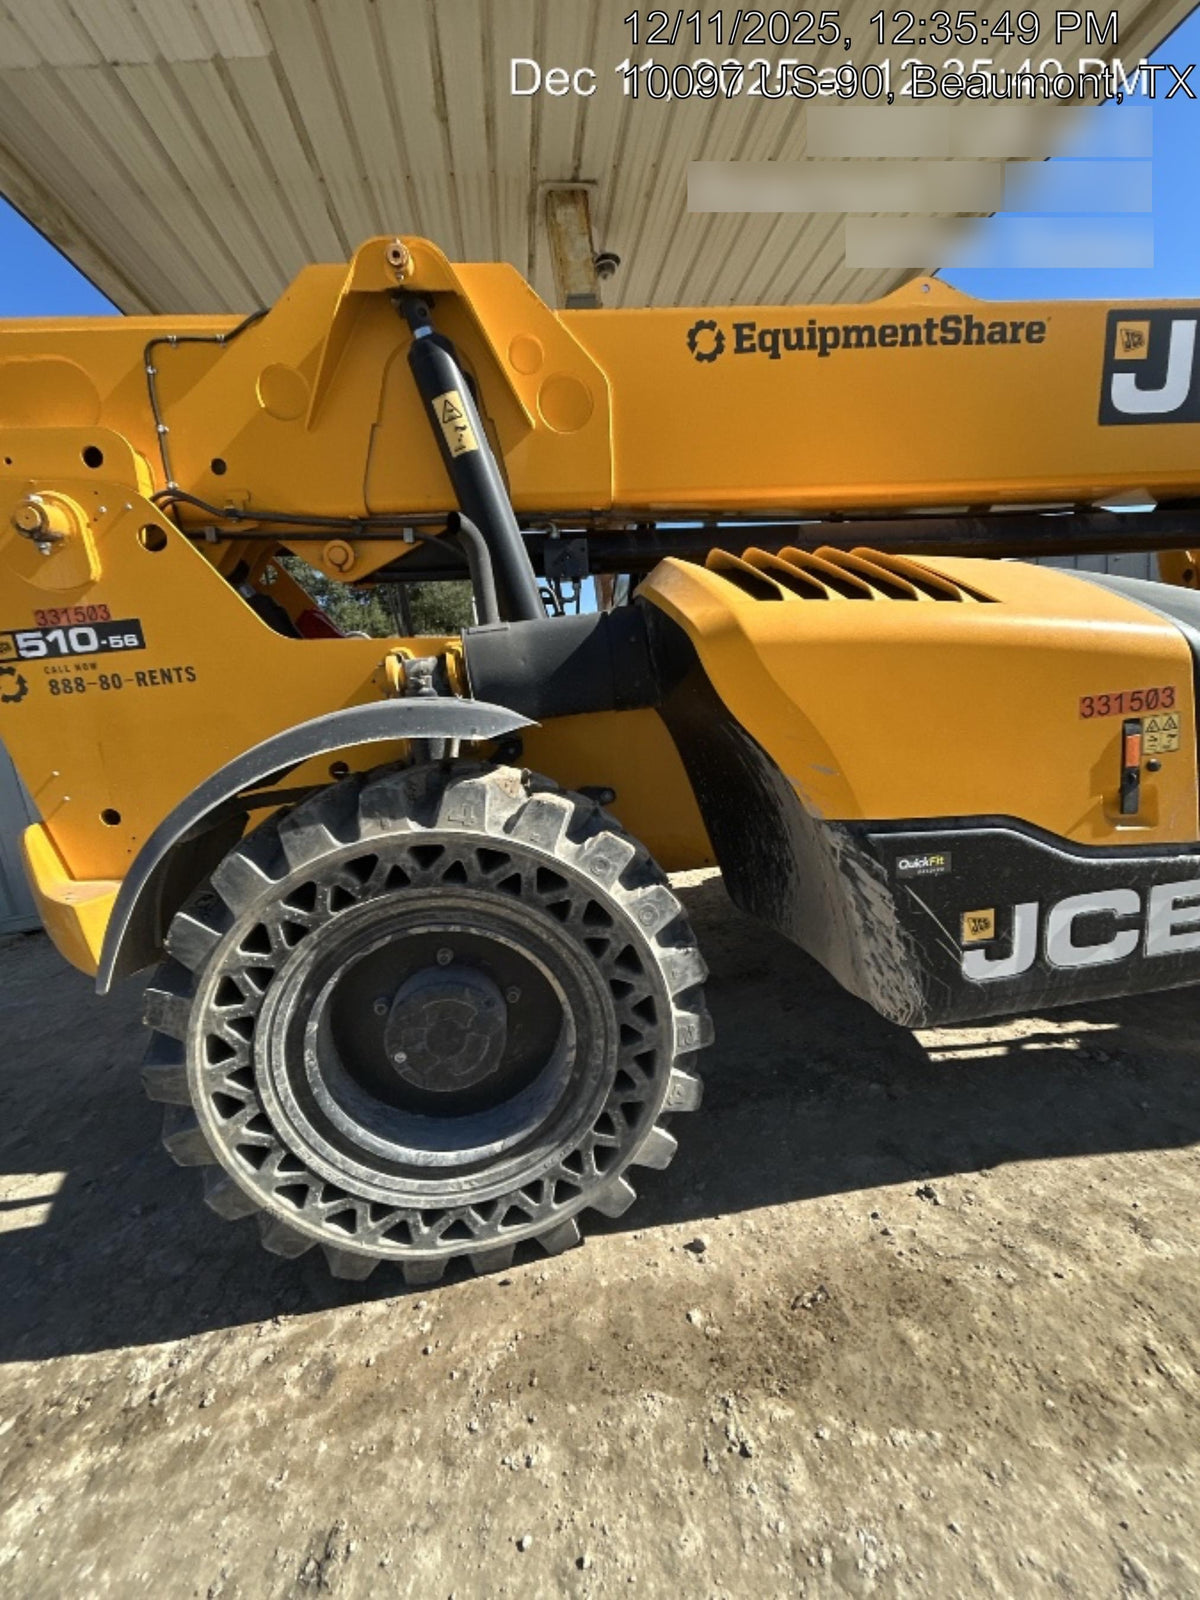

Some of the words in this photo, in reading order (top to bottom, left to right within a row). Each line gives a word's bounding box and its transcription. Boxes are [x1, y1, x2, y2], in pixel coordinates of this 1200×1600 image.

[732, 314, 1046, 360] EquipmentShare
[34, 604, 111, 626] 331503
[48, 666, 197, 696] 888-80-RENTS
[1080, 686, 1176, 719] 331503
[898, 856, 945, 870] QuickFit
